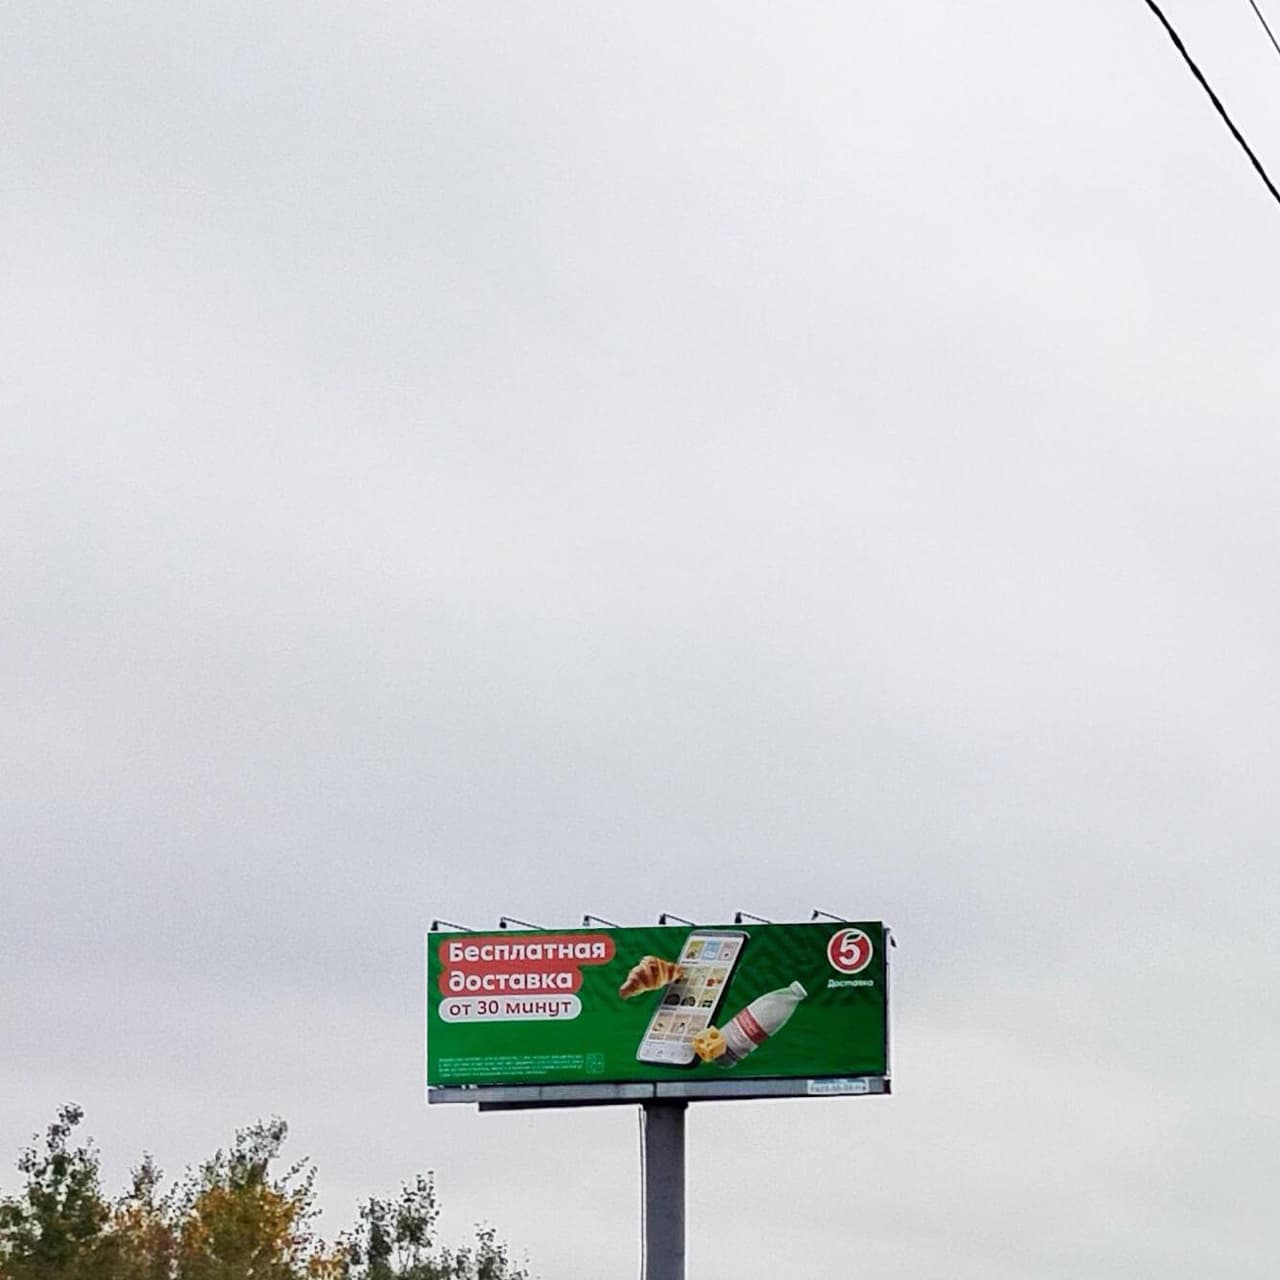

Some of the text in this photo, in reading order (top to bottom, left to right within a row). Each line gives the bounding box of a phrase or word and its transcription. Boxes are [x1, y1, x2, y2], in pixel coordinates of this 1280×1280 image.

[449, 941, 606, 963] Бесплатная
[448, 970, 573, 992] доставка
[449, 1000, 572, 1017] от 30 минут
